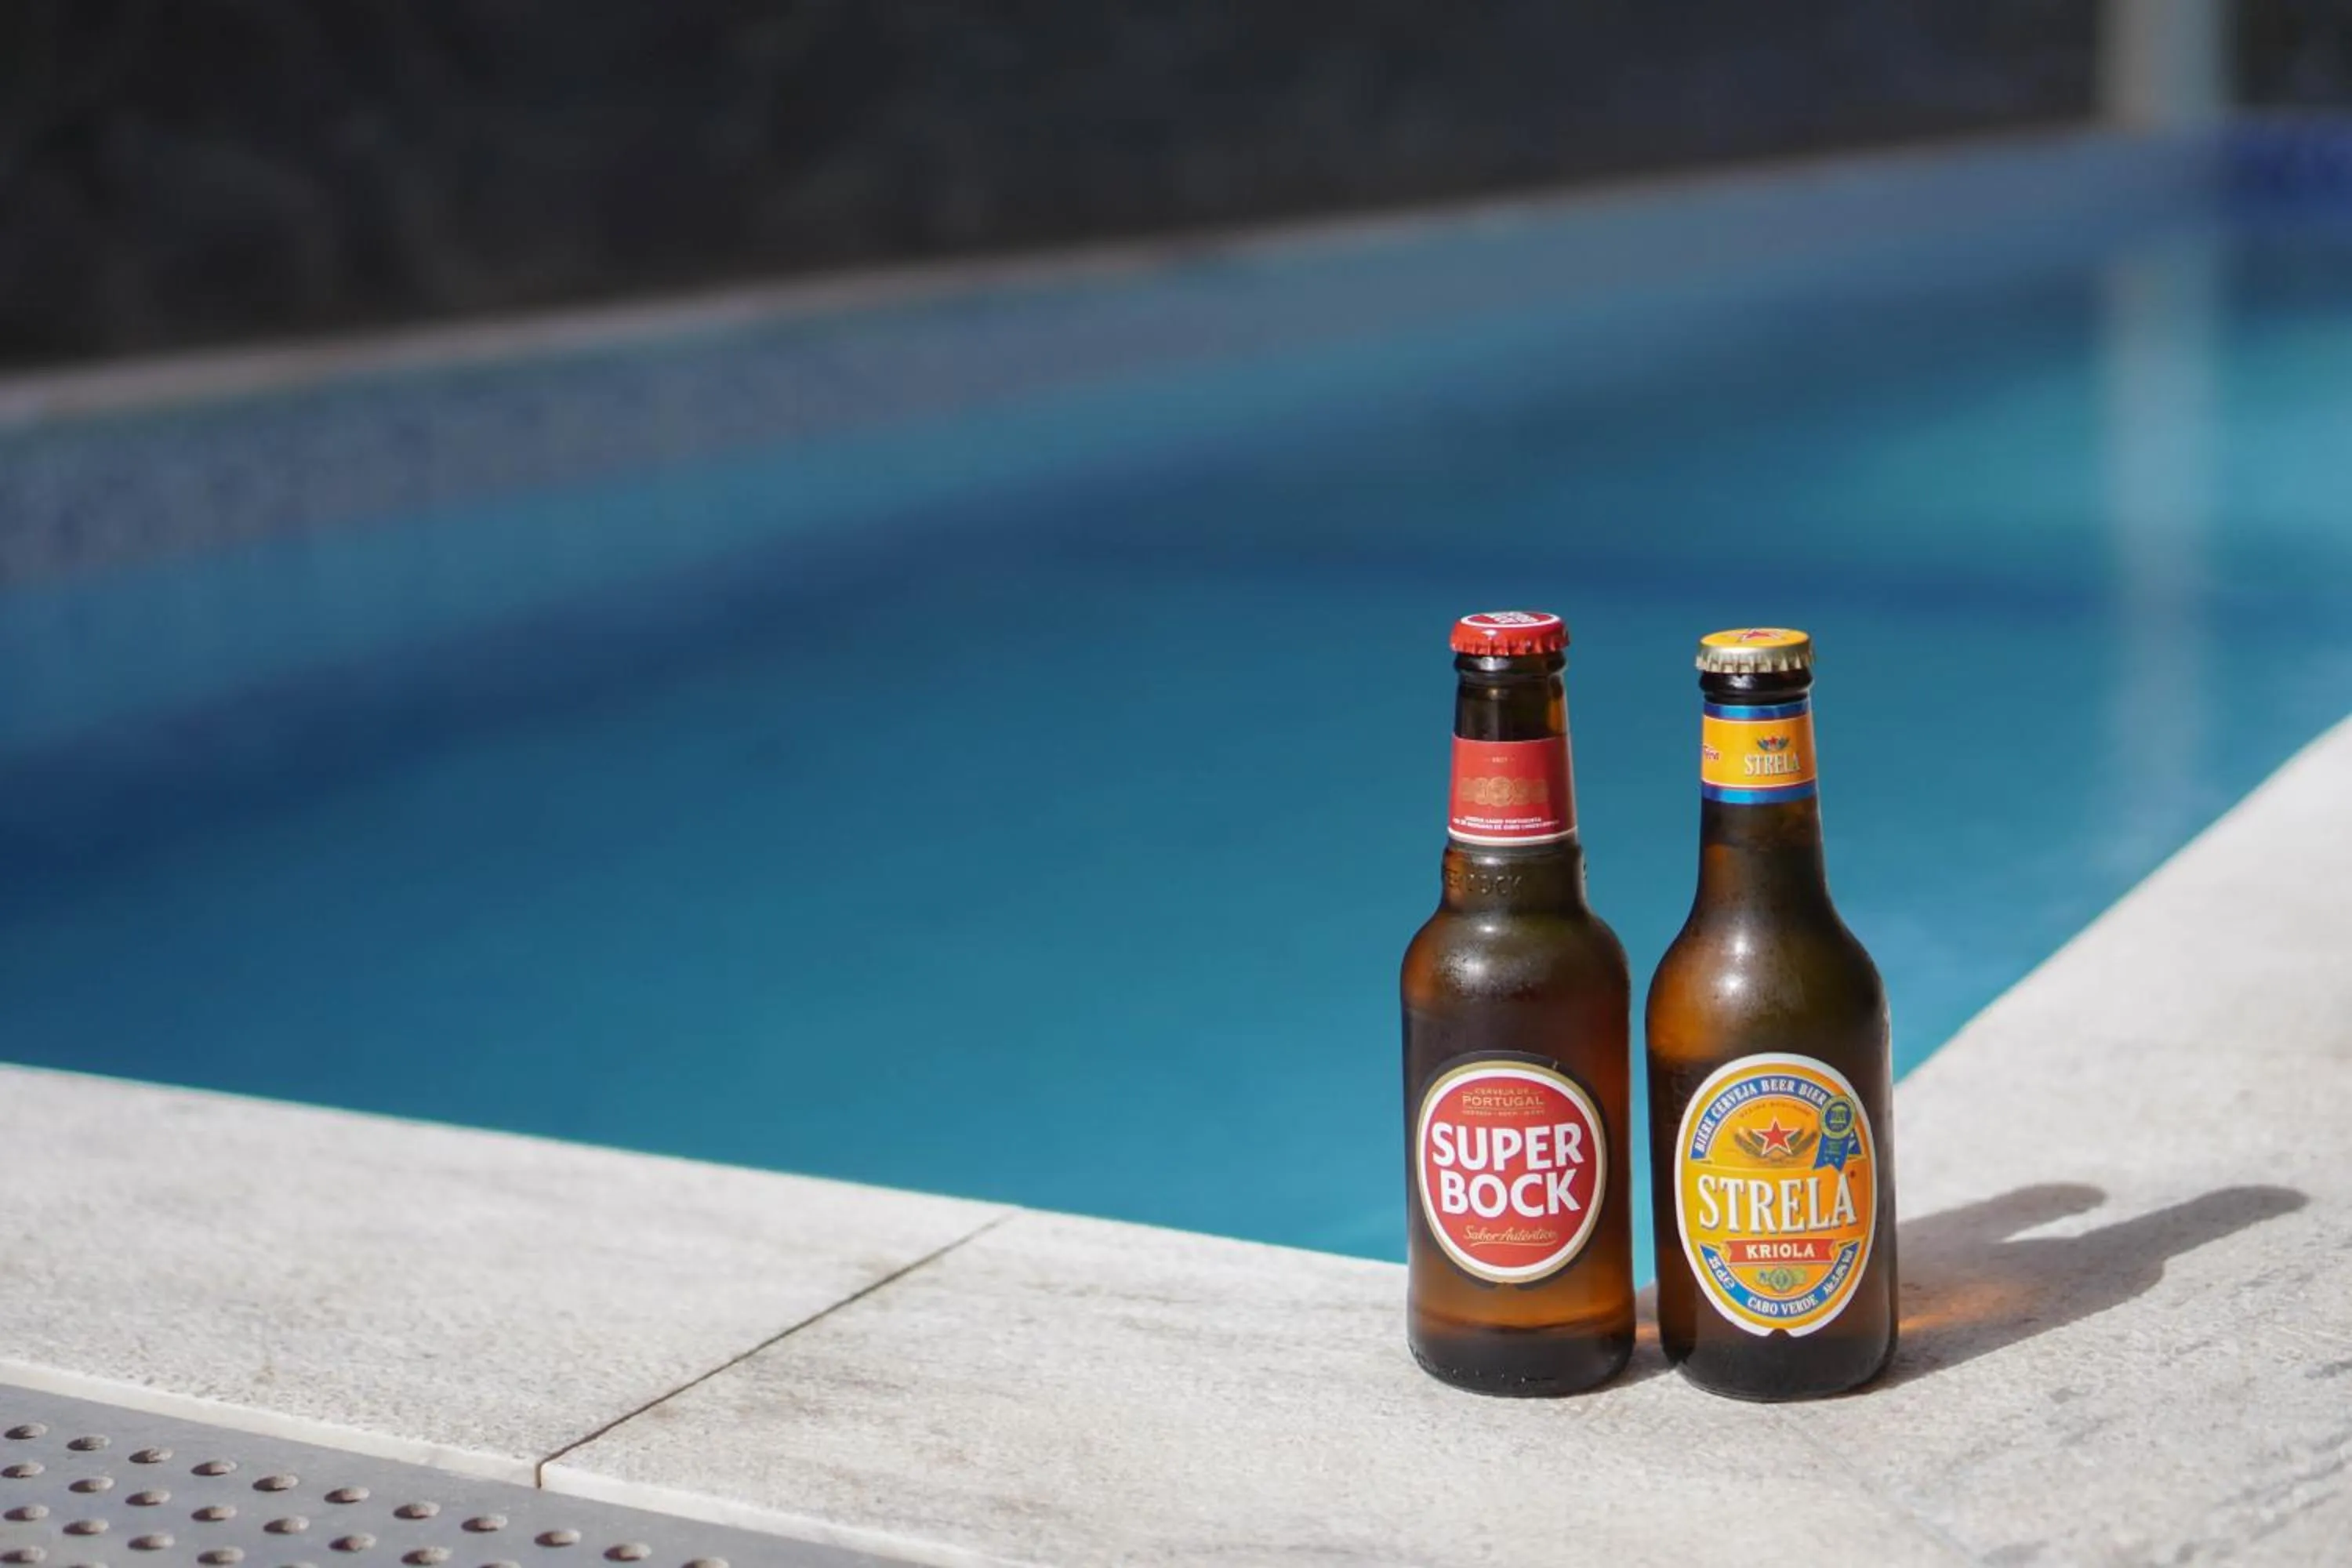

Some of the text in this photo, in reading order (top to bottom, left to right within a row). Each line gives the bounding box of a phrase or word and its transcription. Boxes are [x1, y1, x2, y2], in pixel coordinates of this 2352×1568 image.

[1744, 753, 1801, 776] STRELA
[1462, 1095, 1544, 1106] PORTUGAL
[1711, 1083, 1757, 1120] CERVEJA
[1761, 1079, 1795, 1092] BEER
[1432, 1122, 1584, 1171] SUPER
[1440, 1169, 1581, 1218] BOCK
[1697, 1173, 1857, 1234] STRELA
[1746, 1243, 1815, 1259] KRIOLA
[1747, 1293, 1820, 1316] CABO VERDE
